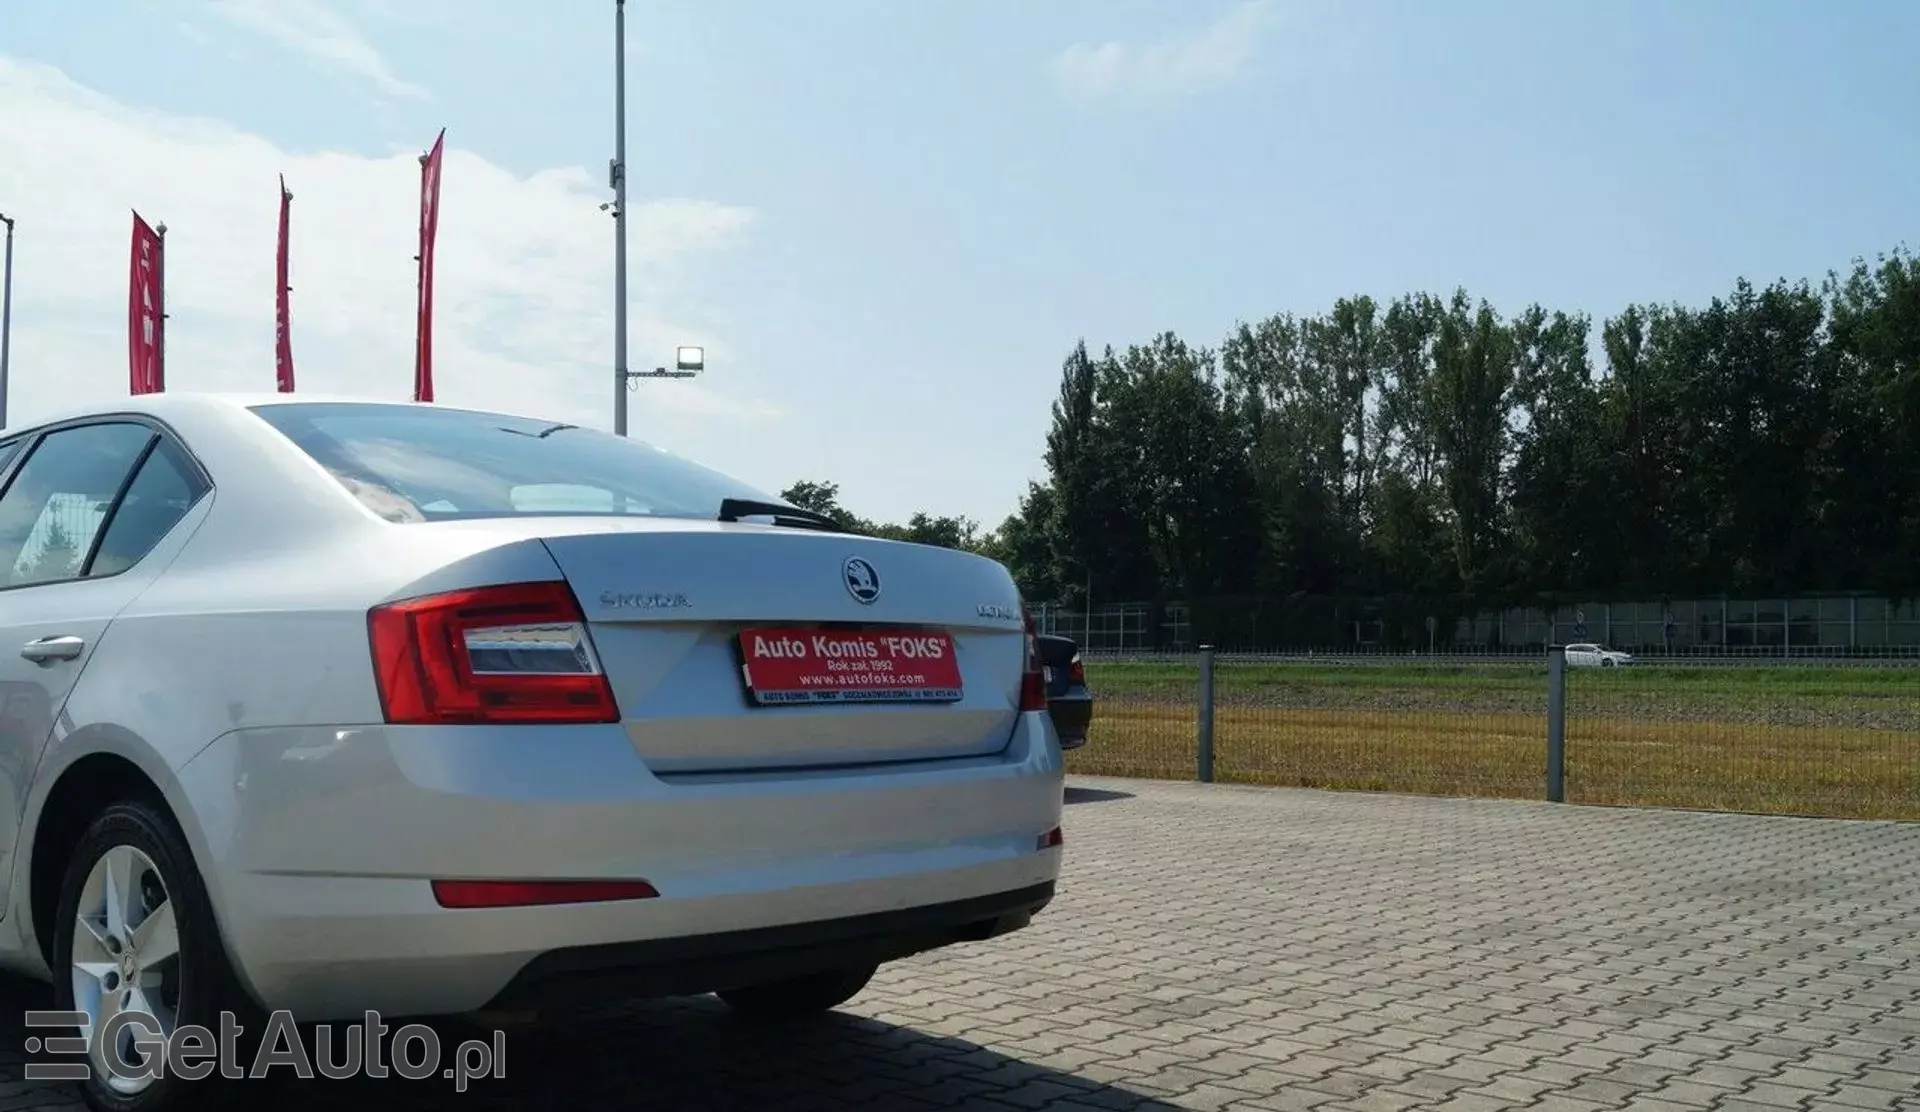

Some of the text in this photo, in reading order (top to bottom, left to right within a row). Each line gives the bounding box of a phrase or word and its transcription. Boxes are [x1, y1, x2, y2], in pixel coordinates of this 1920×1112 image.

[754, 636, 946, 659] Auto Komis "FOKS"
[827, 659, 849, 671] Rok
[799, 672, 925, 685] www.autofoks.com
